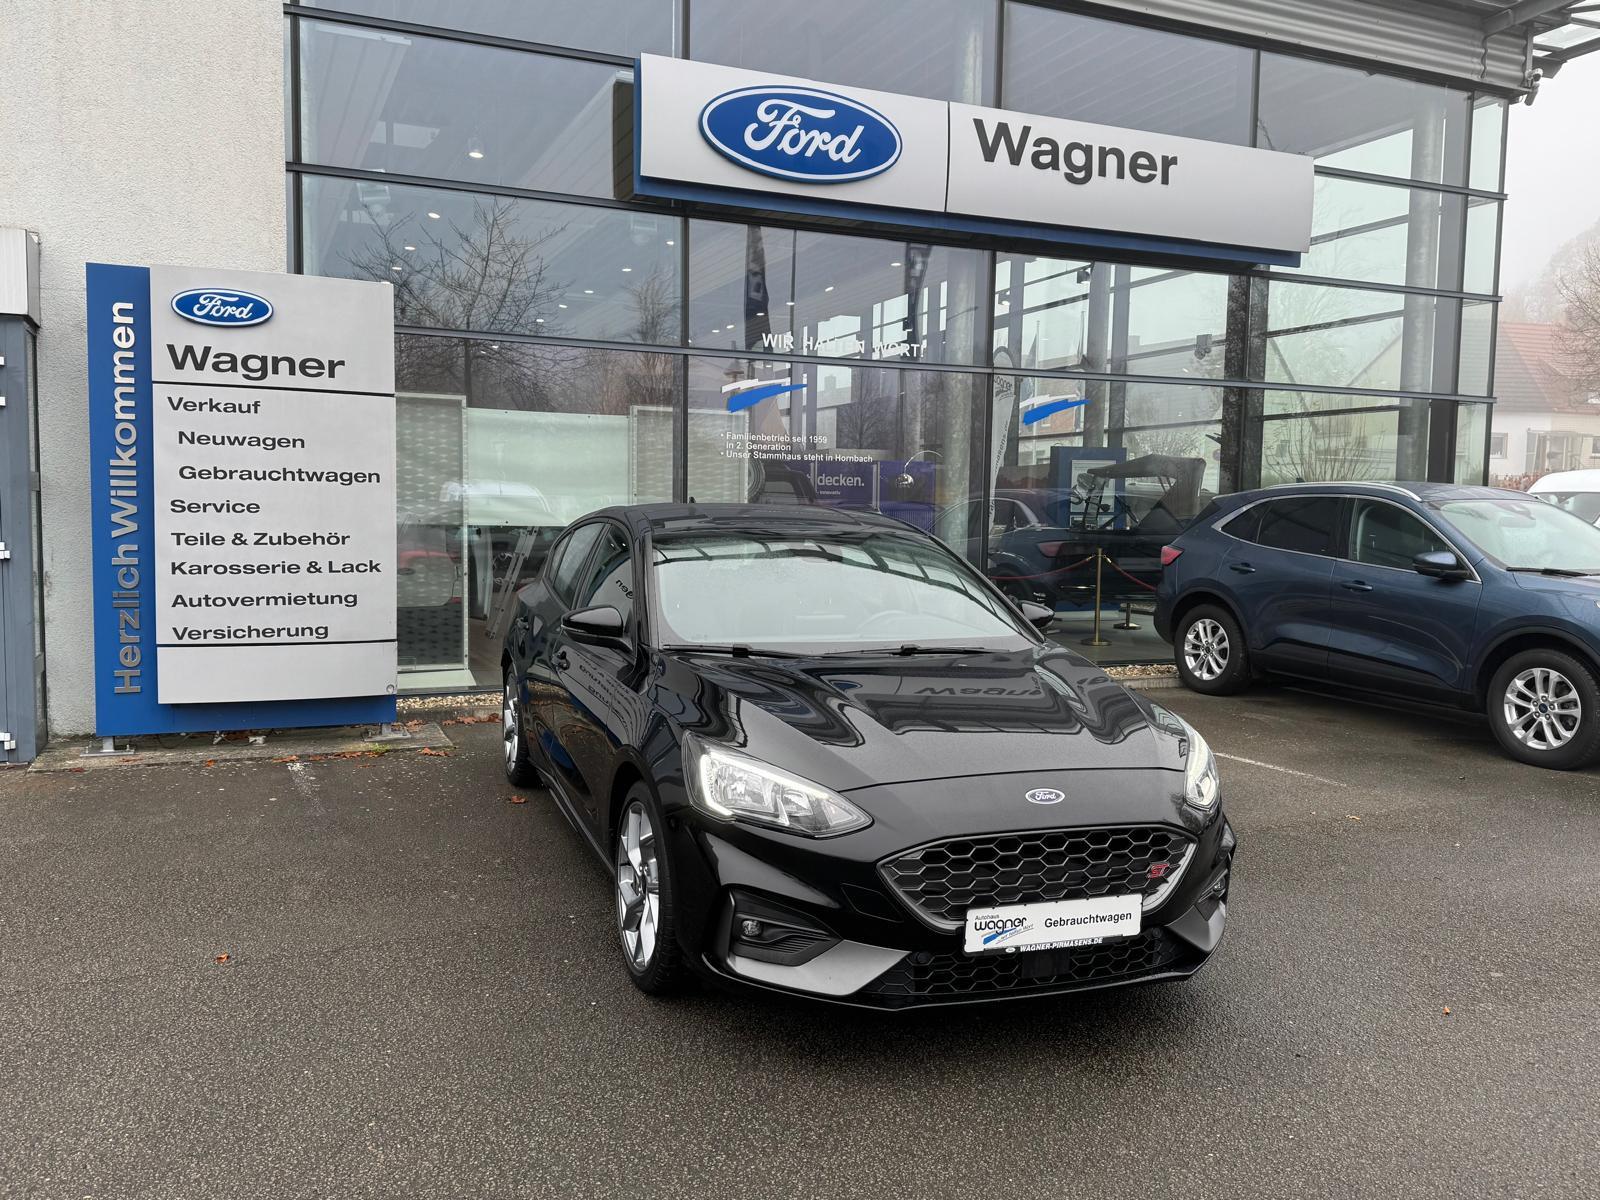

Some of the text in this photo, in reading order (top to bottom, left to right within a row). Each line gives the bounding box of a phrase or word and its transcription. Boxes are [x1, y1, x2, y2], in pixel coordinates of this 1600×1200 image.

[743, 98, 866, 164] Ford
[972, 117, 1179, 186] Wagner
[192, 293, 254, 320] Ford
[762, 332, 794, 349] WIR
[166, 343, 346, 382] Wagner
[167, 396, 262, 414] Verkauf
[178, 430, 306, 451] Neuwagen
[726, 431, 828, 444] Familienbetrieb seit 1959
[746, 442, 792, 451] Generation
[726, 450, 751, 459] Unser
[753, 451, 802, 461] Stammhaus
[803, 453, 824, 462] steht
[835, 454, 873, 463] Hornbach
[178, 465, 382, 486] Gebrauchtwagen
[817, 473, 865, 487] decken.
[109, 301, 142, 694] Herzlich Willkommen
[170, 498, 261, 514] Service
[171, 531, 351, 546] Teile & Zubehör
[170, 559, 382, 575] Karosserie & Lack
[171, 591, 358, 608] Autovermietung
[172, 623, 330, 641] Versicherung
[1146, 862, 1170, 880] ST
[974, 917, 1027, 935] wagner
[1044, 912, 1132, 928] Gebrauchtwagen
[1020, 937, 1104, 952] WAGNER-PIRMASENS.DE
